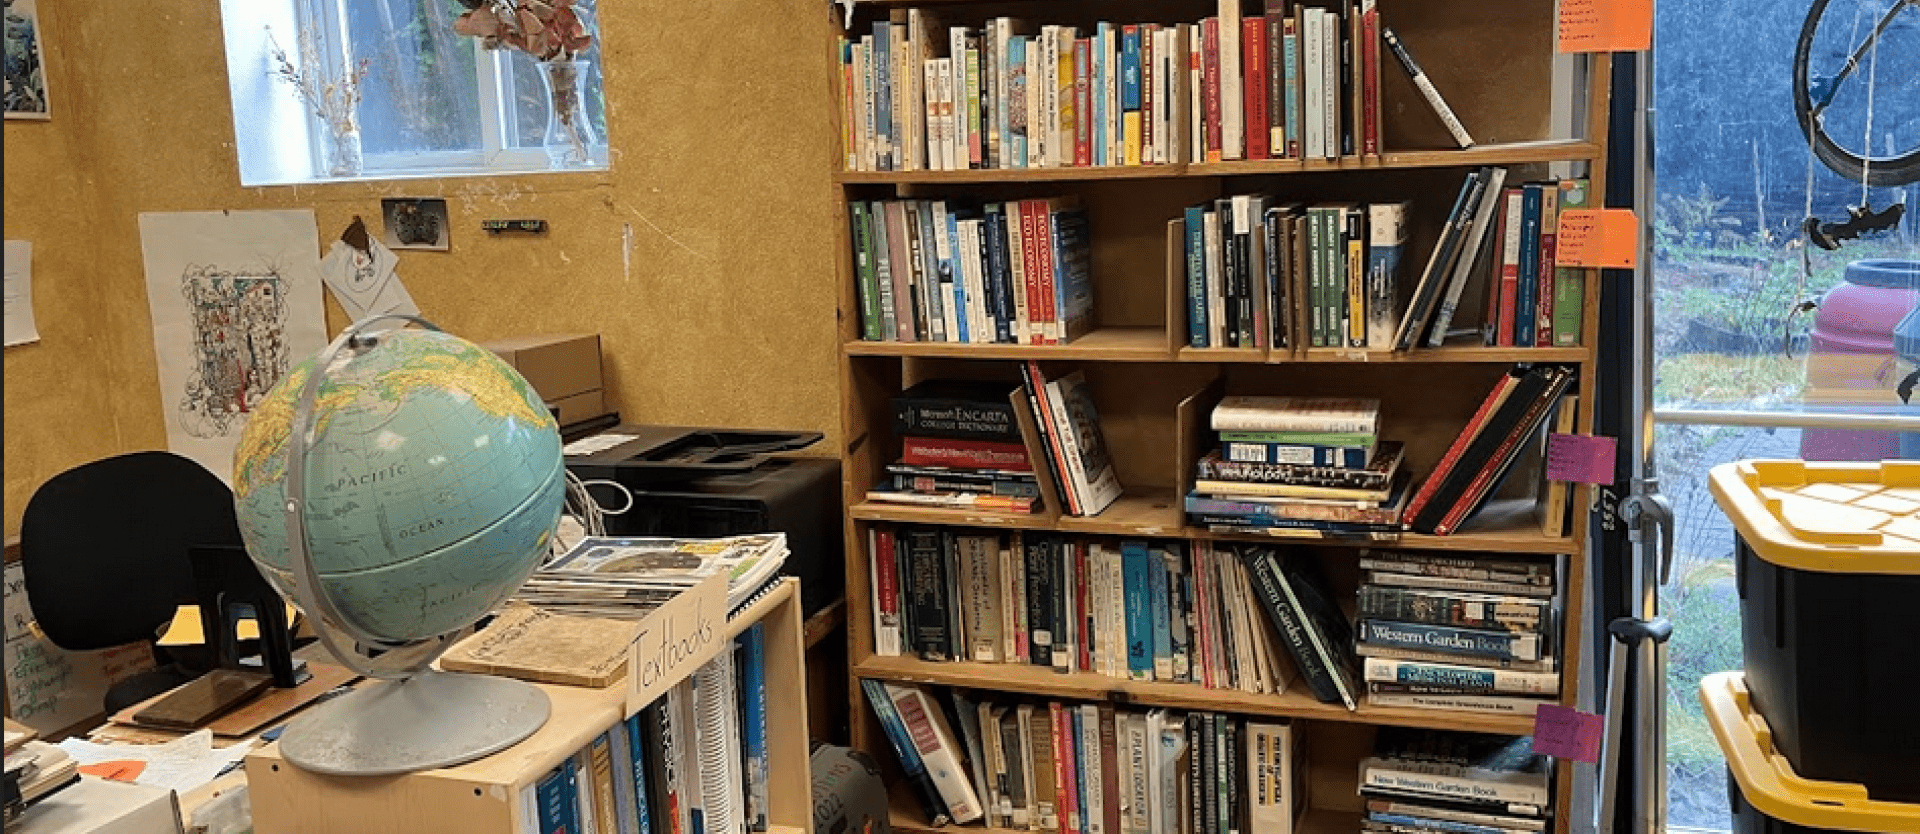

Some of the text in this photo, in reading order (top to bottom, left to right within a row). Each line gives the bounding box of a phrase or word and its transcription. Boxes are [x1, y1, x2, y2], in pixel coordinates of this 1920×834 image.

[955, 406, 1009, 422] ENCARTA
[338, 464, 408, 487] PACIFIC
[398, 511, 446, 538] OCEAN
[1254, 554, 1280, 604] Western
[1276, 602, 1303, 647] Garden
[632, 597, 712, 695] Textbooks
[1371, 624, 1512, 653] Western Garden Book
[1374, 775, 1498, 797] New Western Garden Book
